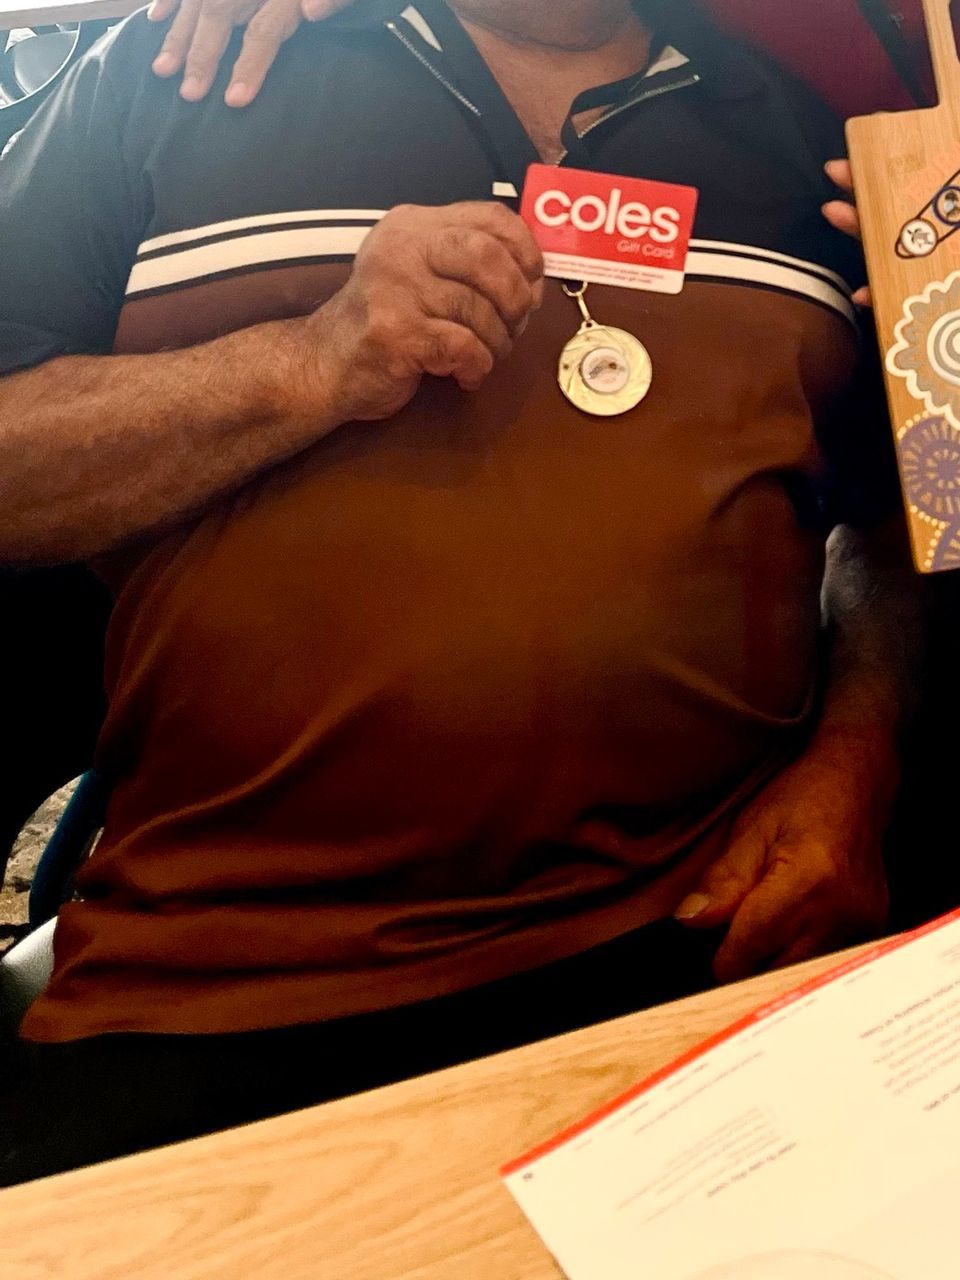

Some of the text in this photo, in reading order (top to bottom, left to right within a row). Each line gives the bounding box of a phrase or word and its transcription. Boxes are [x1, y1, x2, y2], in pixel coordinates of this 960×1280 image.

[534, 187, 681, 244] coles
[616, 239, 675, 260] Gift Card
